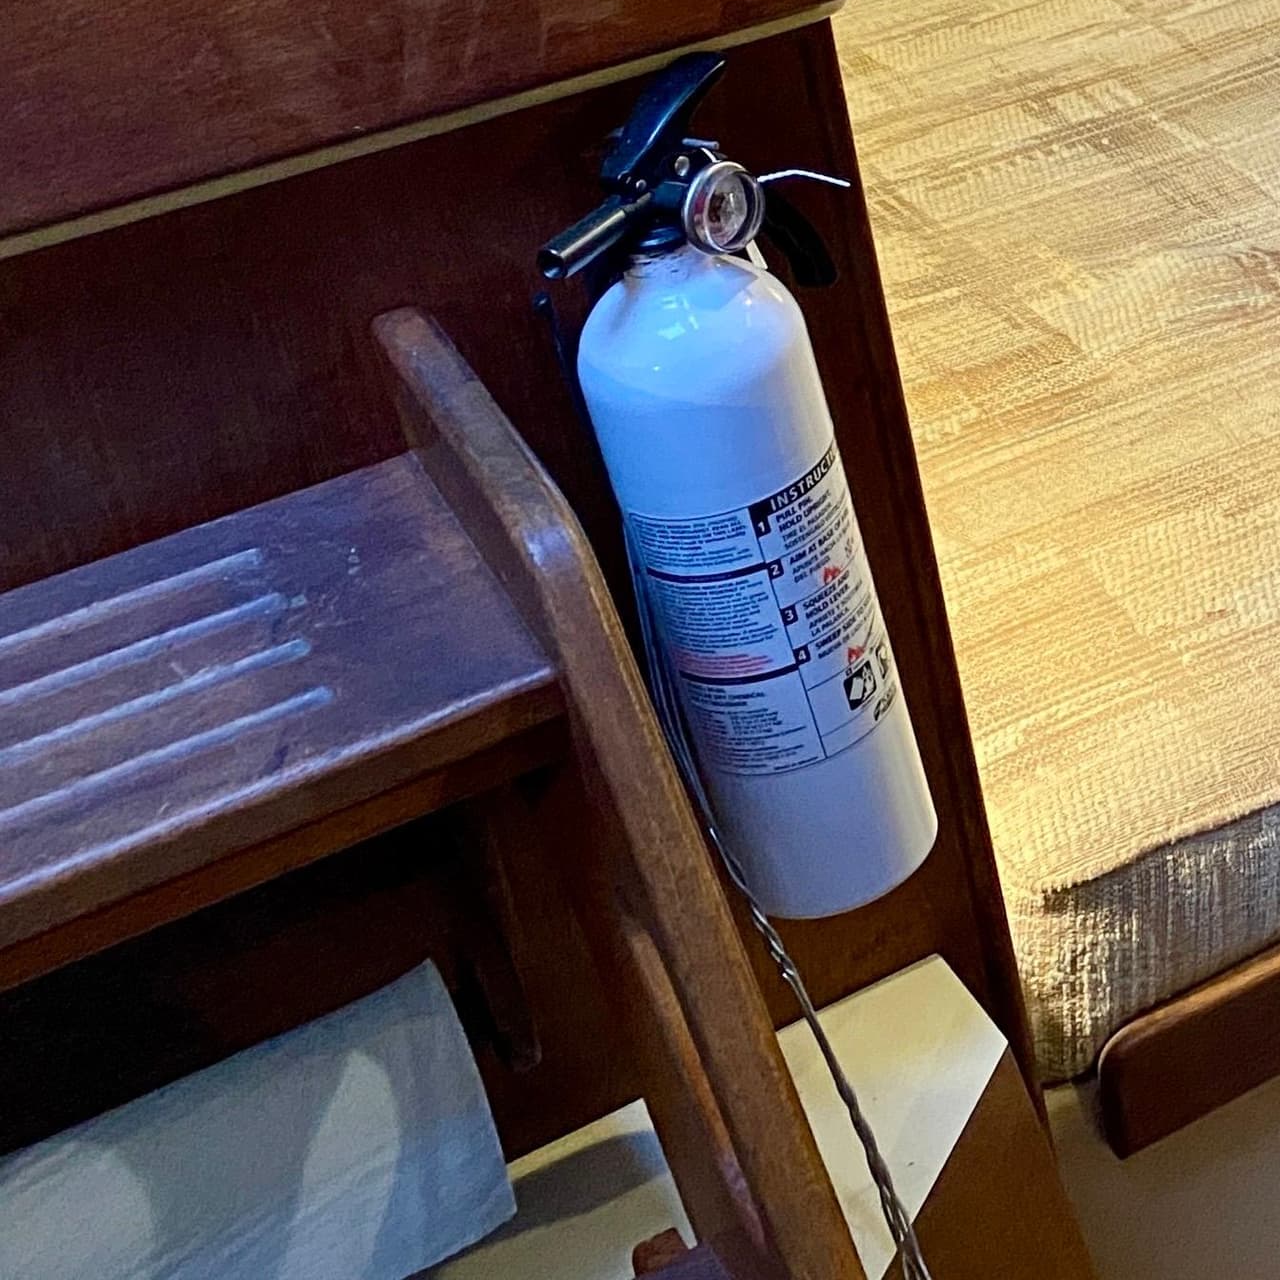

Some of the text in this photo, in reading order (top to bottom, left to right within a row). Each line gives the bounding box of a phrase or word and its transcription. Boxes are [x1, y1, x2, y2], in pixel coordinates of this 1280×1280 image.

[776, 506, 797, 522] PULL
[757, 521, 765, 533] 1
[779, 515, 803, 533] HOLD
[770, 564, 780, 576] 2
[802, 583, 837, 610] SQUEEZE
[784, 609, 794, 621] 3
[805, 600, 829, 619] HOLD
[798, 650, 807, 660] 4
